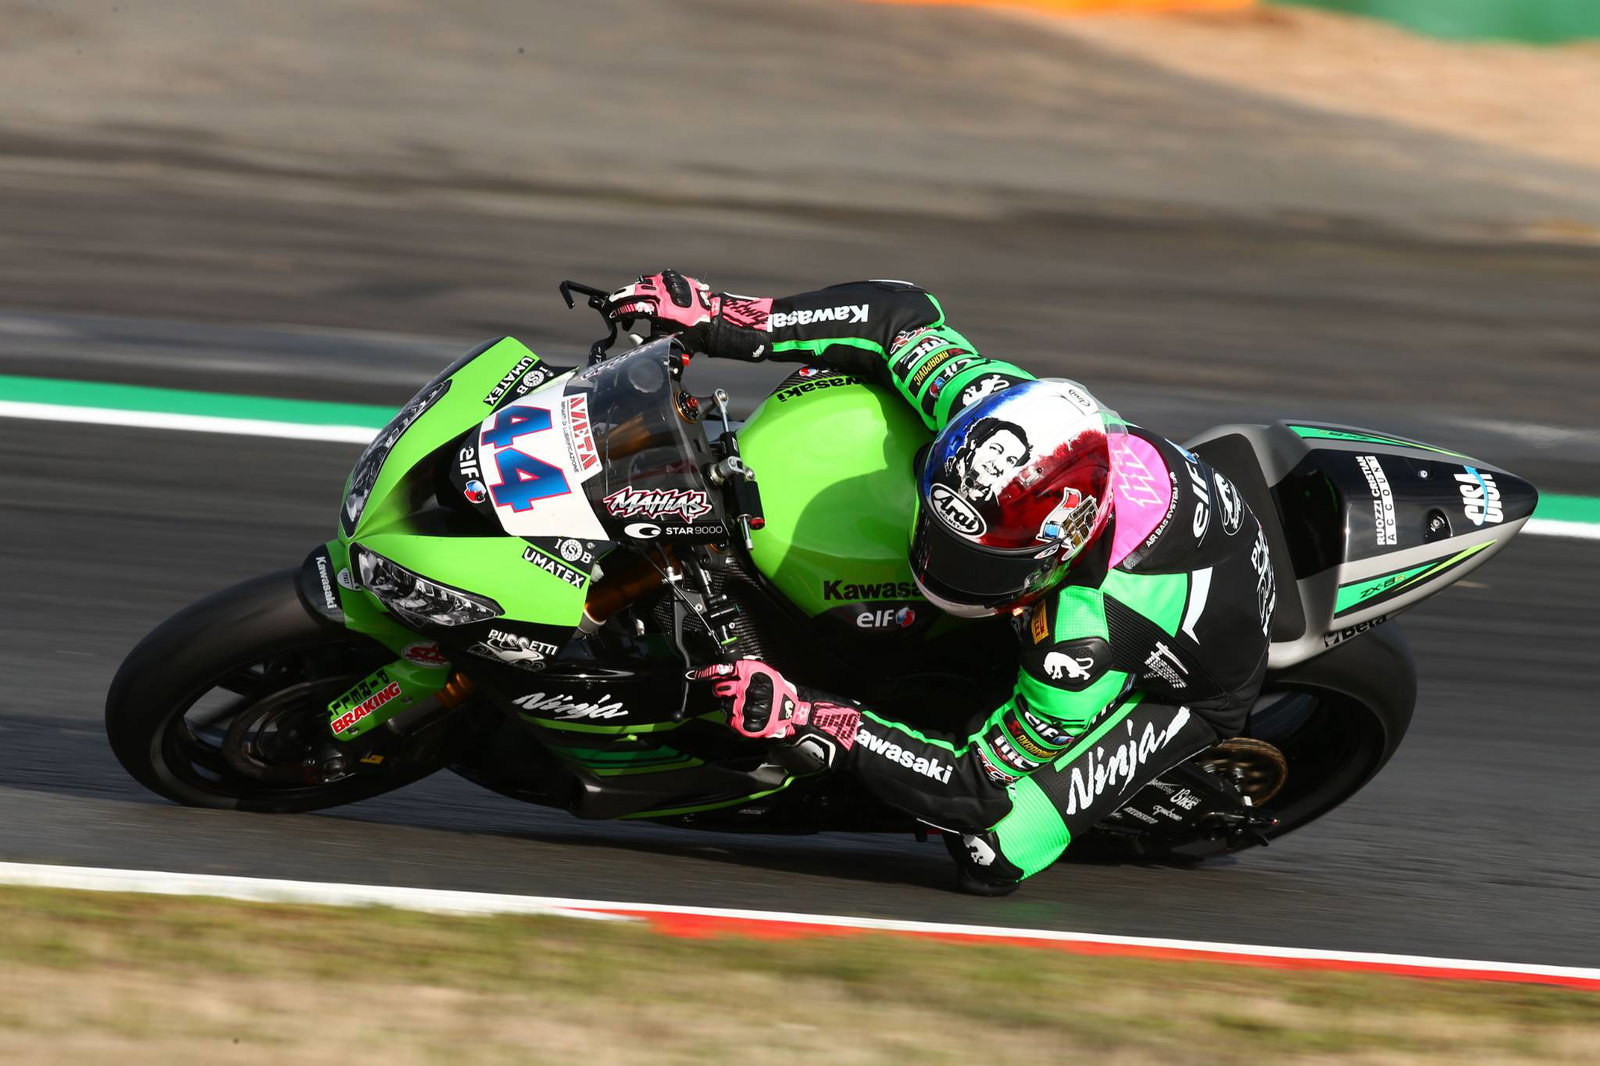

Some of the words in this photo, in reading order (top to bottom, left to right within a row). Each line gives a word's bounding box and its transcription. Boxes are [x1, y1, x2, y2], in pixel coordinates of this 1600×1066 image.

[767, 305, 869, 332] Kawasa
[485, 357, 534, 403] UMATEX
[777, 378, 860, 402] wasaki
[459, 447, 479, 478] elf
[481, 405, 572, 513] 44
[1356, 456, 1380, 498] CRISTIAN
[933, 496, 979, 529] Arai
[1185, 461, 1209, 538] elf
[1367, 457, 1396, 541] ACCOUNT
[1145, 534, 1158, 548] AIR
[1155, 518, 1169, 536] BAG
[1373, 500, 1385, 545] RUOZZI
[315, 556, 337, 608] Kawasaki
[523, 548, 584, 588] UMATEX
[823, 580, 922, 600] Kawasa
[856, 609, 894, 627] elf
[330, 681, 401, 735] BRAKING
[512, 692, 628, 719] Ninja
